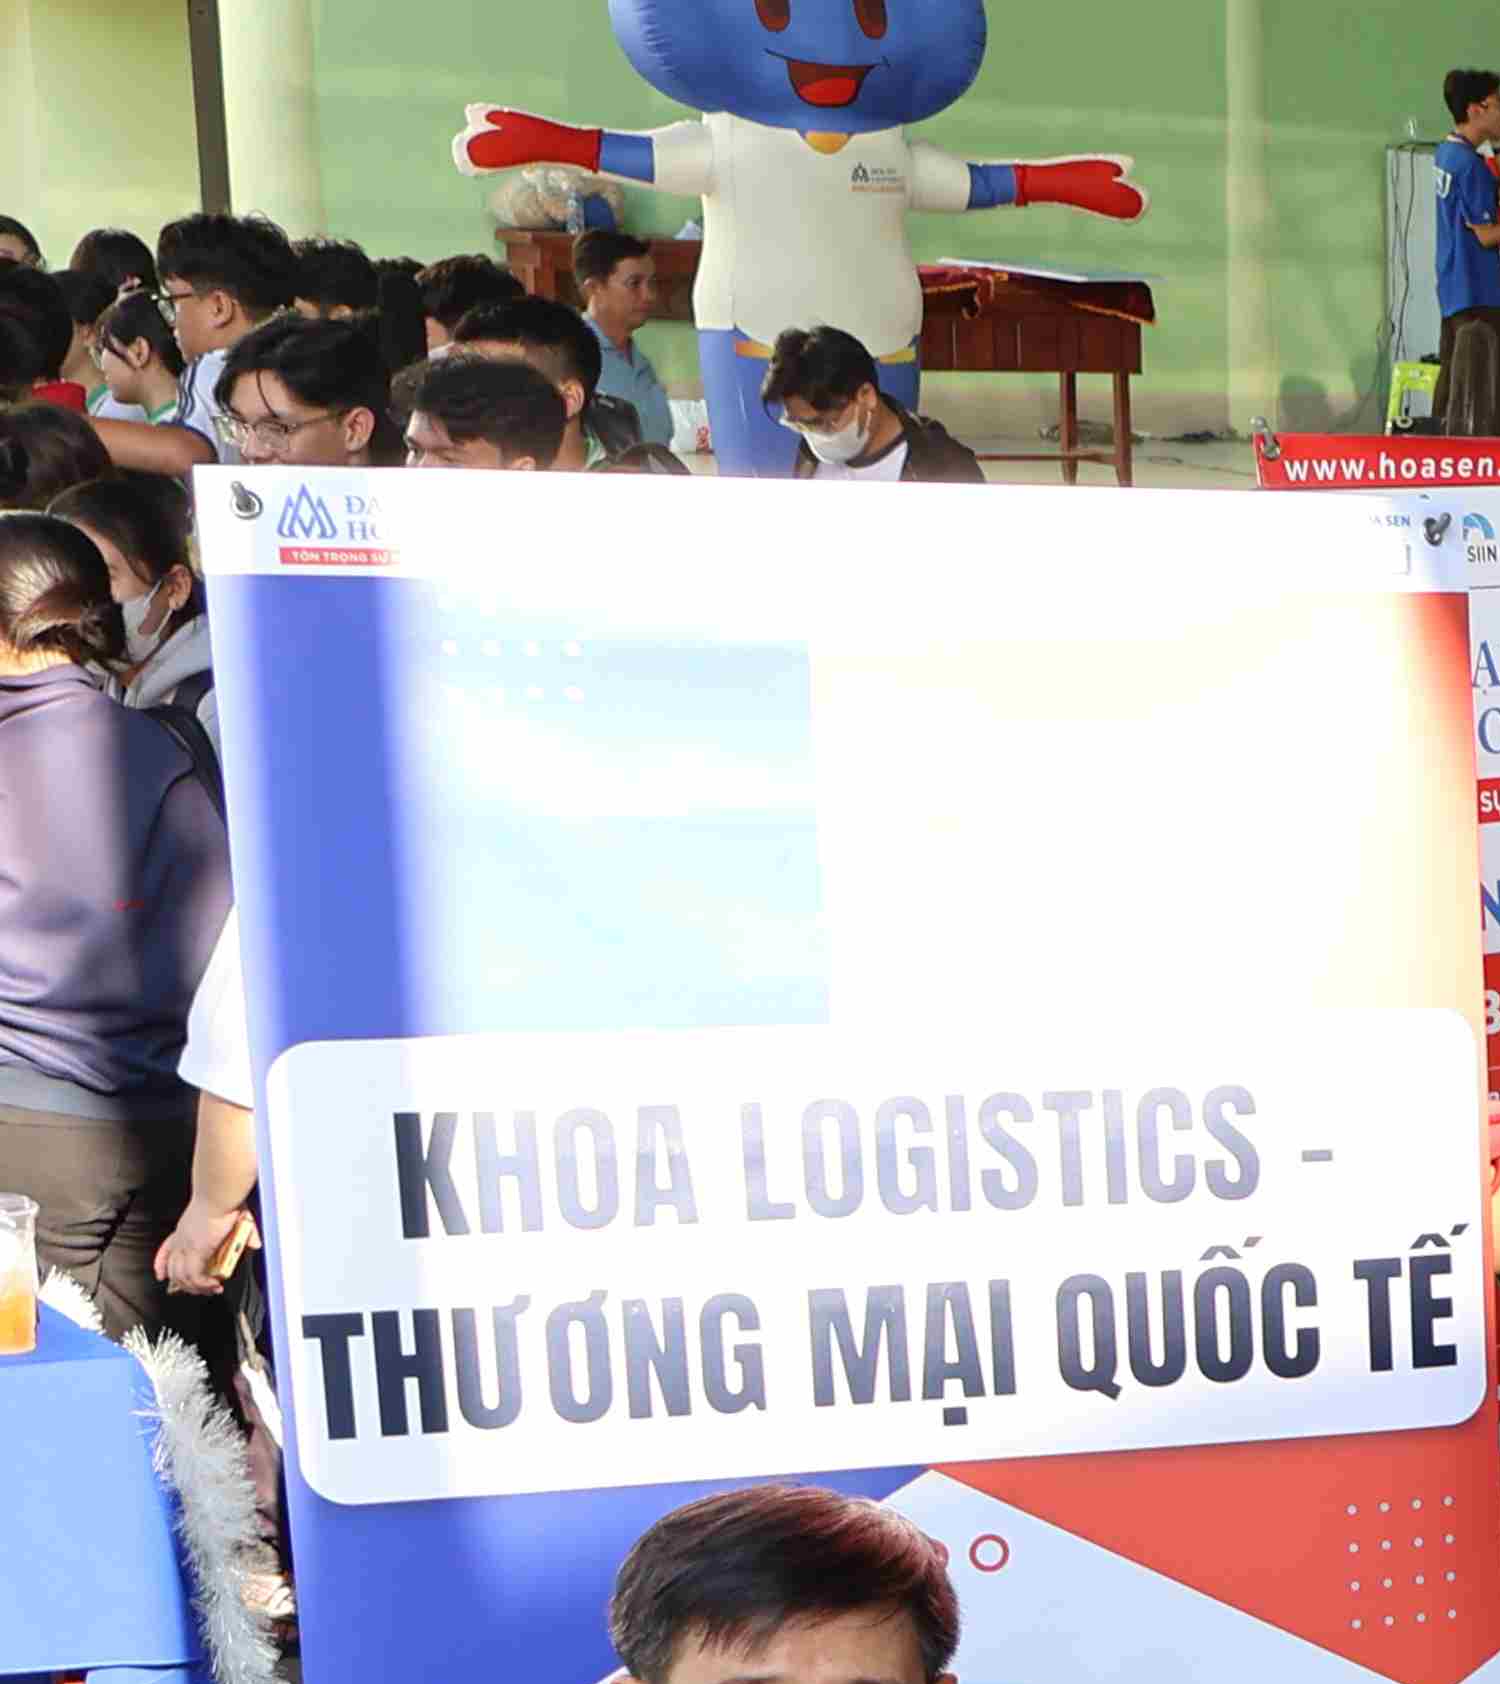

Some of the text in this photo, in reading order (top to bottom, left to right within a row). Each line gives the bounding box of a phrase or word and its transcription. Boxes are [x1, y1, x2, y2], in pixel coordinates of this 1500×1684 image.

[393, 1102, 701, 1243] KHOA
[741, 1082, 1263, 1225] LOGISTICS
[302, 1219, 1471, 1443] THƯƠNG MẠI QUỐC TẾ
